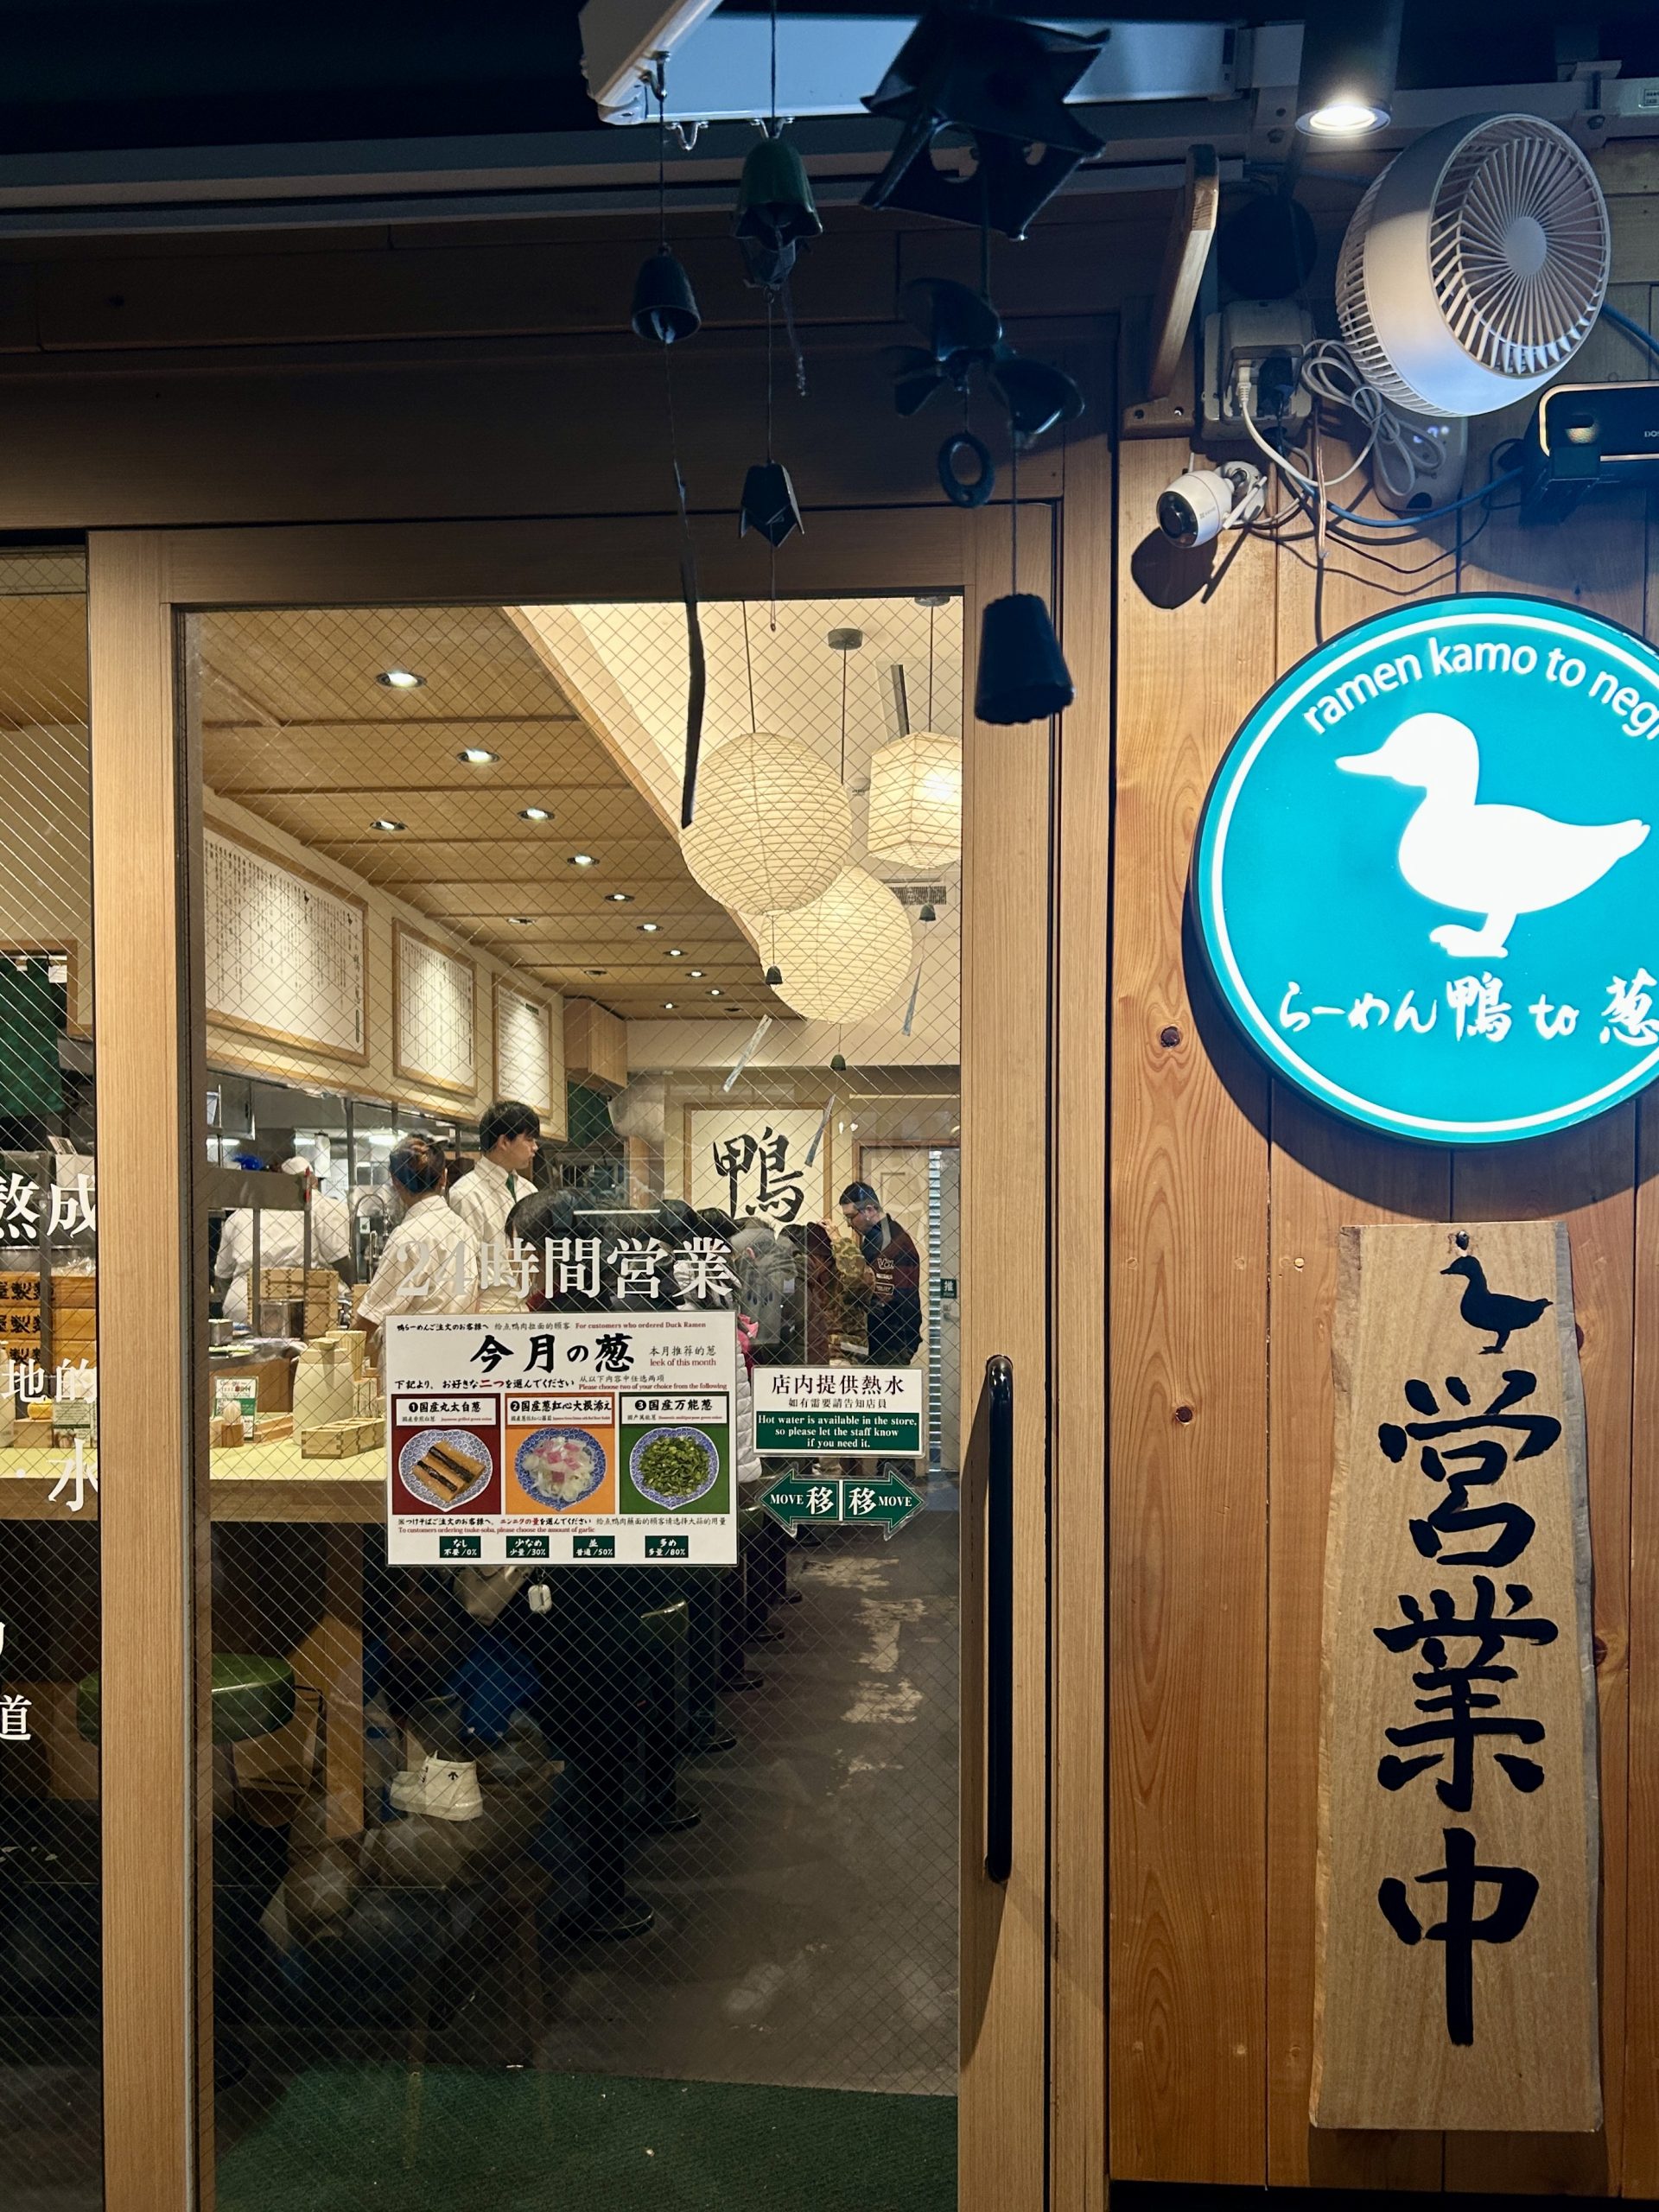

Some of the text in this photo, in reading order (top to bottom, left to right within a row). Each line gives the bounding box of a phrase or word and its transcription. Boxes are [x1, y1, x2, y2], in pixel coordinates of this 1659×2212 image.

[1303, 653, 1423, 734] ramen
[1428, 637, 1538, 677] kamo
[1545, 647, 1586, 688] to
[713, 1126, 804, 1224] 鴨
[397, 1236, 734, 1300] 24時間営業
[470, 1333, 634, 1373] 今月の葱
[772, 1374, 905, 1395] 店内提供熱水
[789, 1398, 887, 1409] 如有需要請告知店員
[759, 1414, 775, 1424] Hot
[778, 1415, 804, 1425] water
[807, 1414, 816, 1424] is
[817, 1414, 860, 1425] available
[862, 1415, 871, 1425] in
[874, 1415, 888, 1426] the
[788, 1427, 817, 1437] please
[819, 1427, 831, 1436] let
[834, 1427, 848, 1436] the
[850, 1427, 872, 1436] staff
[874, 1427, 899, 1437] know
[807, 1438, 871, 1449] if you need it.
[770, 1486, 834, 1515] MOVE 移
[848, 1487, 912, 1516] 移 MOVE
[453, 1539, 467, 1548] なし
[515, 1538, 542, 1548] 少なめ
[660, 1538, 677, 1548] 多め
[1374, 1370, 1561, 2045] 営業中
